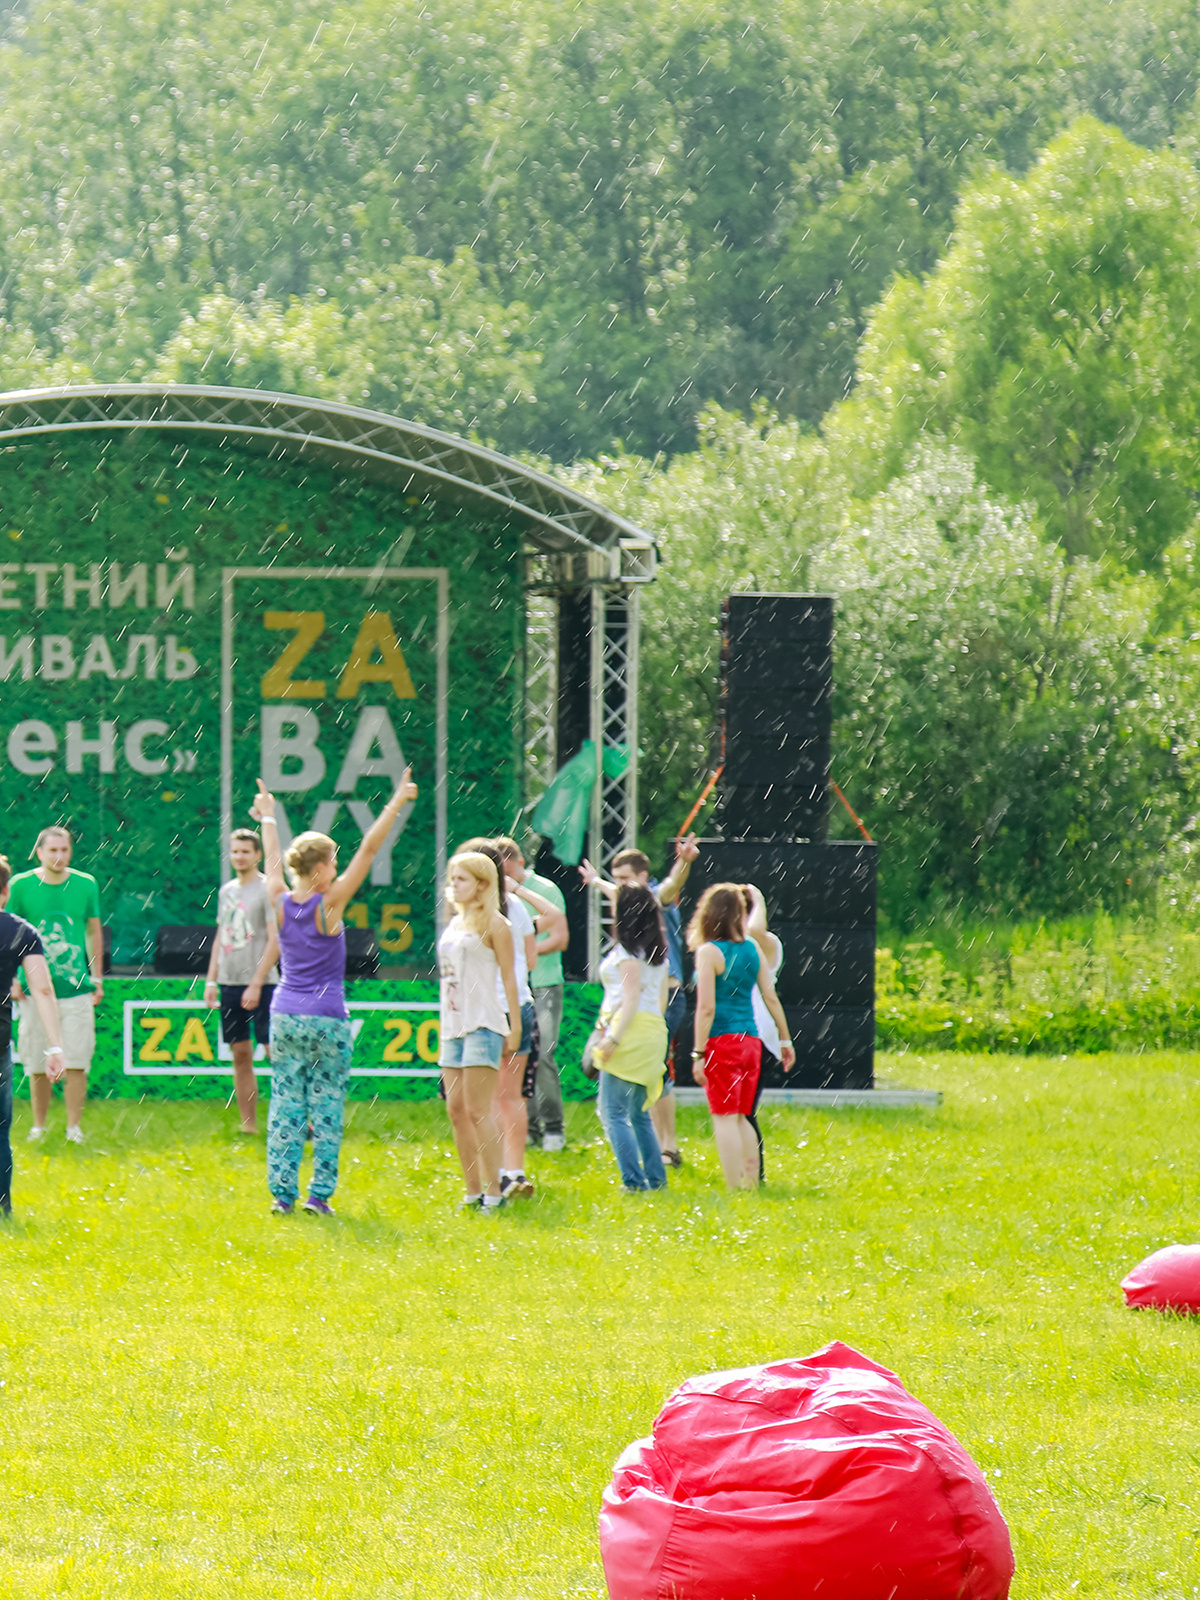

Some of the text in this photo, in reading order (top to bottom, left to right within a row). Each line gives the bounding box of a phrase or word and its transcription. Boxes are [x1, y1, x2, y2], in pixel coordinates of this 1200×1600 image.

[261, 611, 417, 699] ZA
[346, 903, 414, 952] 15
[383, 1019, 442, 1063] 20
